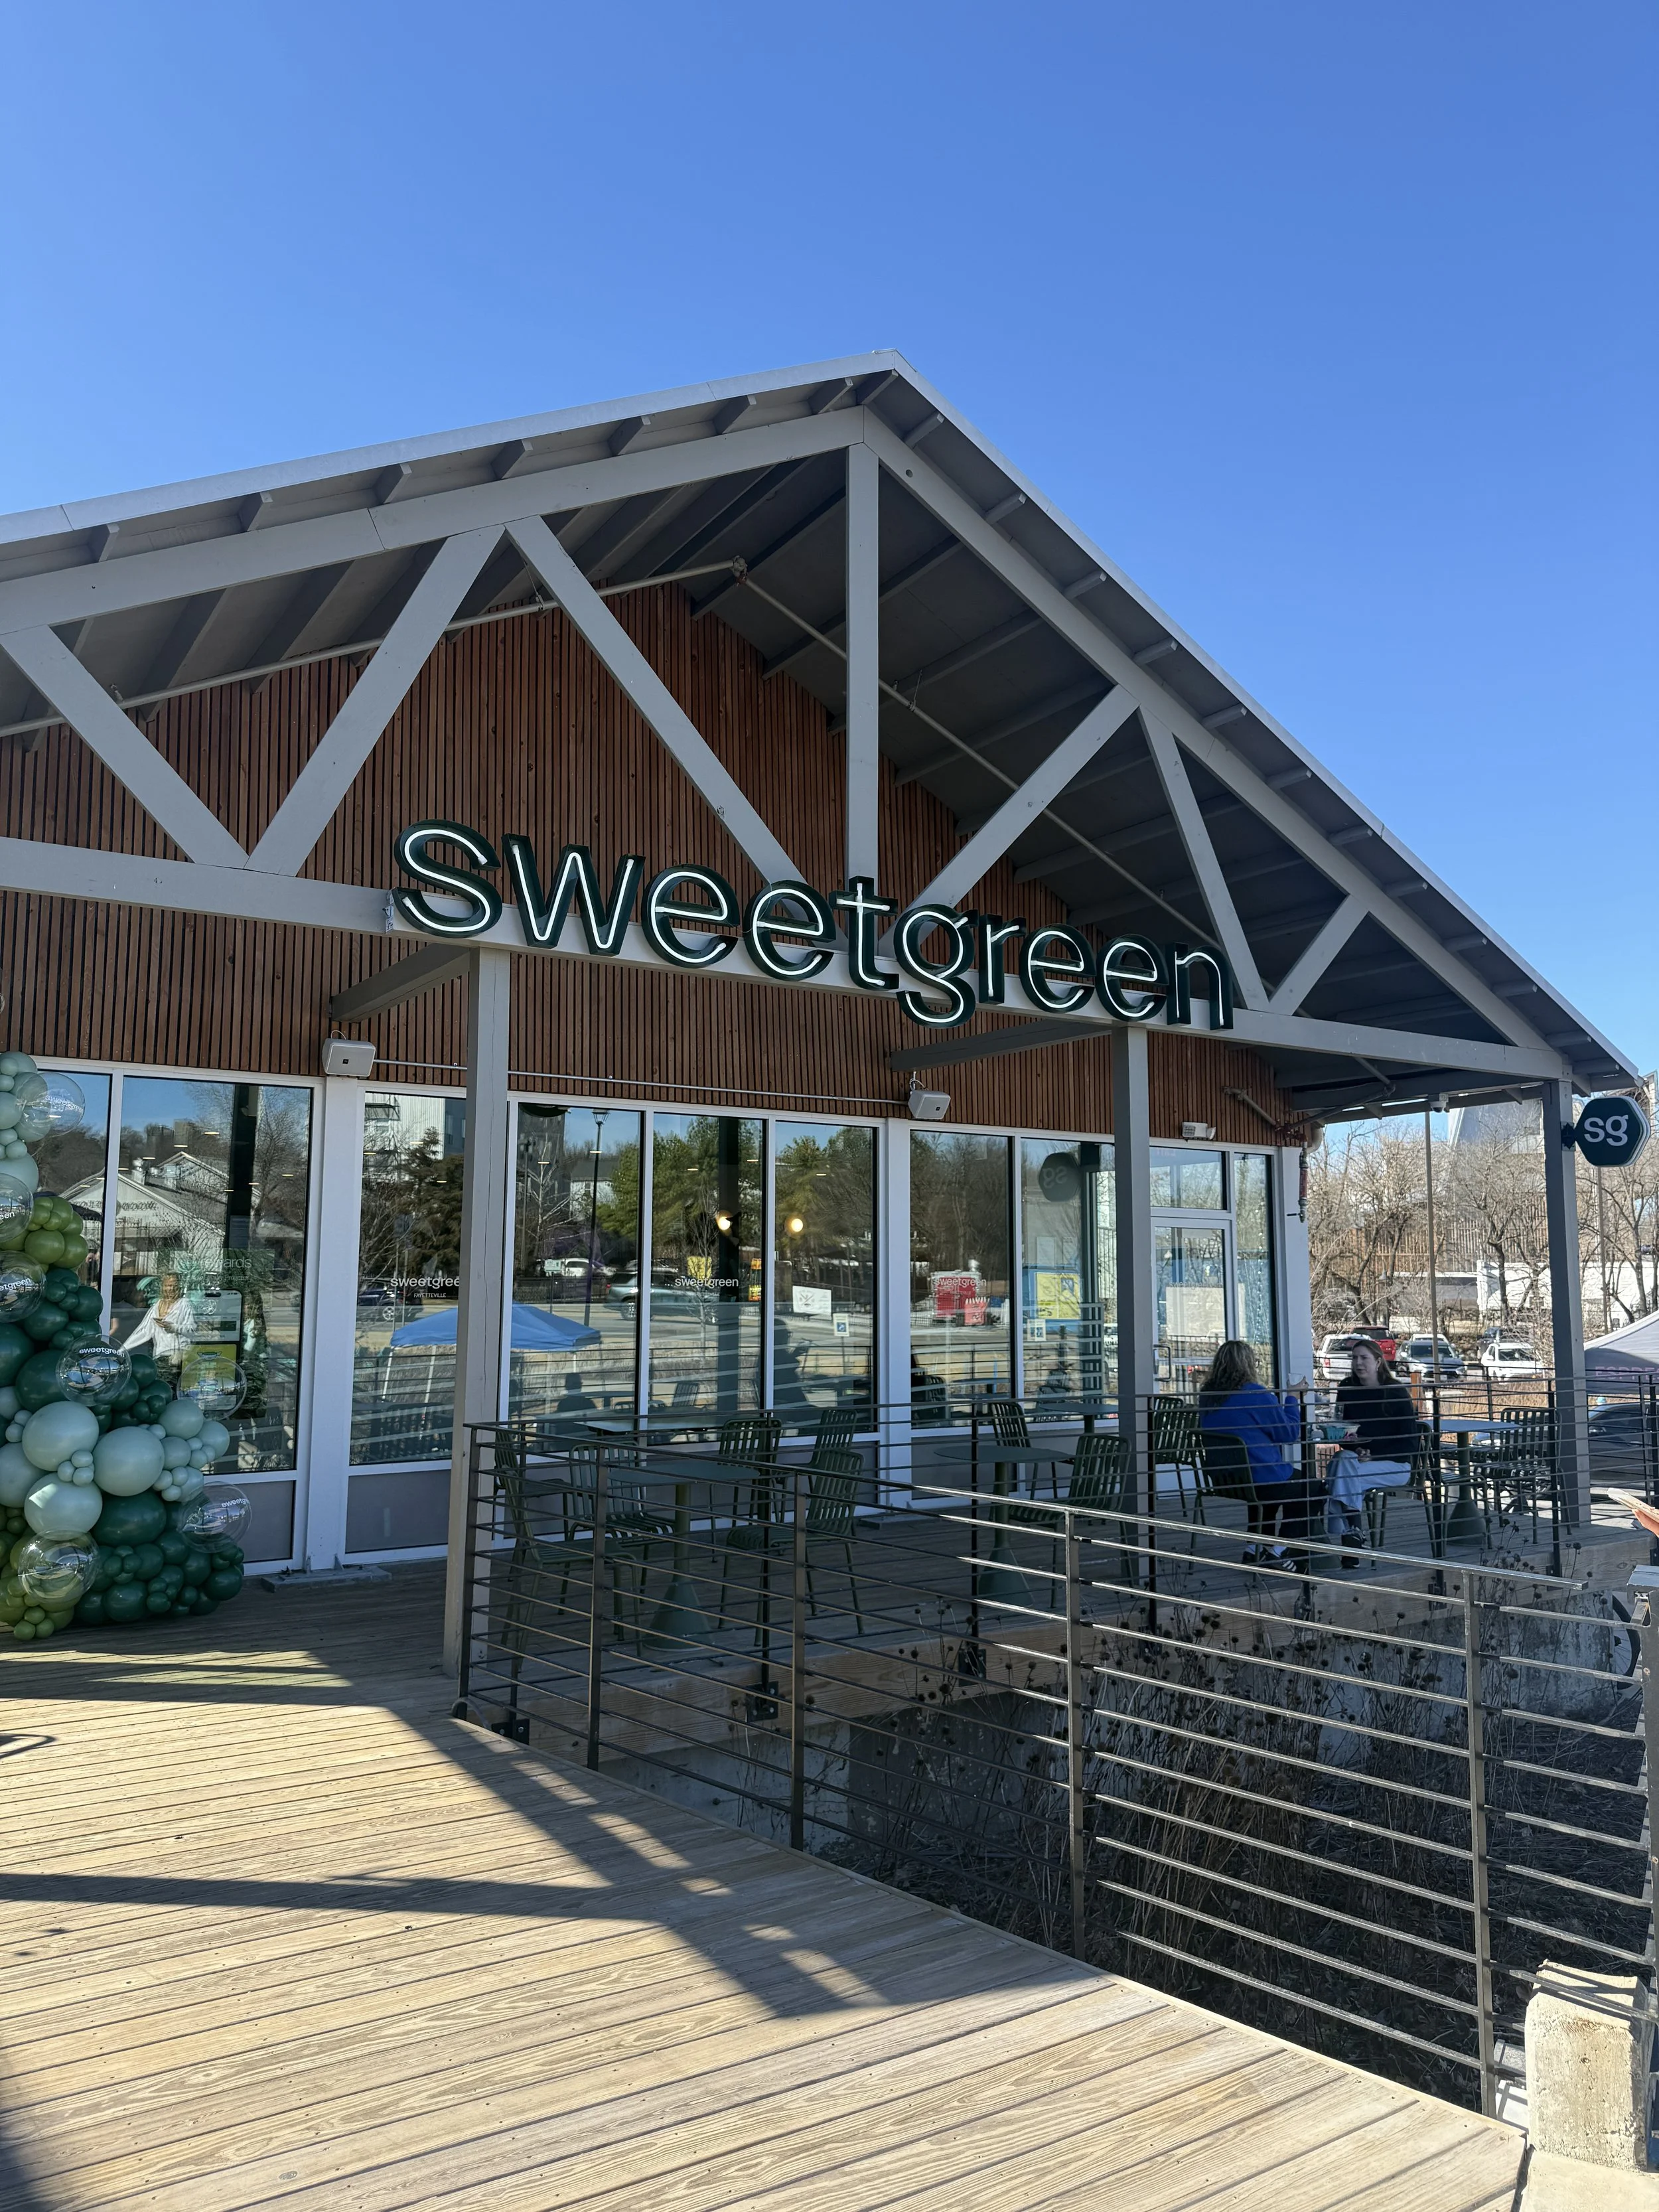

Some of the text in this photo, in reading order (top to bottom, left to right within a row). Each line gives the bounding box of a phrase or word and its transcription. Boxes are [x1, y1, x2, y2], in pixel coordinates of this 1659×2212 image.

[394, 819, 1234, 1030] sweetgreen
[1584, 1115, 1628, 1147] sg
[390, 1276, 460, 1290] sweetgree
[674, 1278, 739, 1289] sweetgreen
[933, 1278, 987, 1288] sweetgreen
[79, 1347, 125, 1358] sweetgreen
[1595, 1366, 1659, 1380] ESPRE
